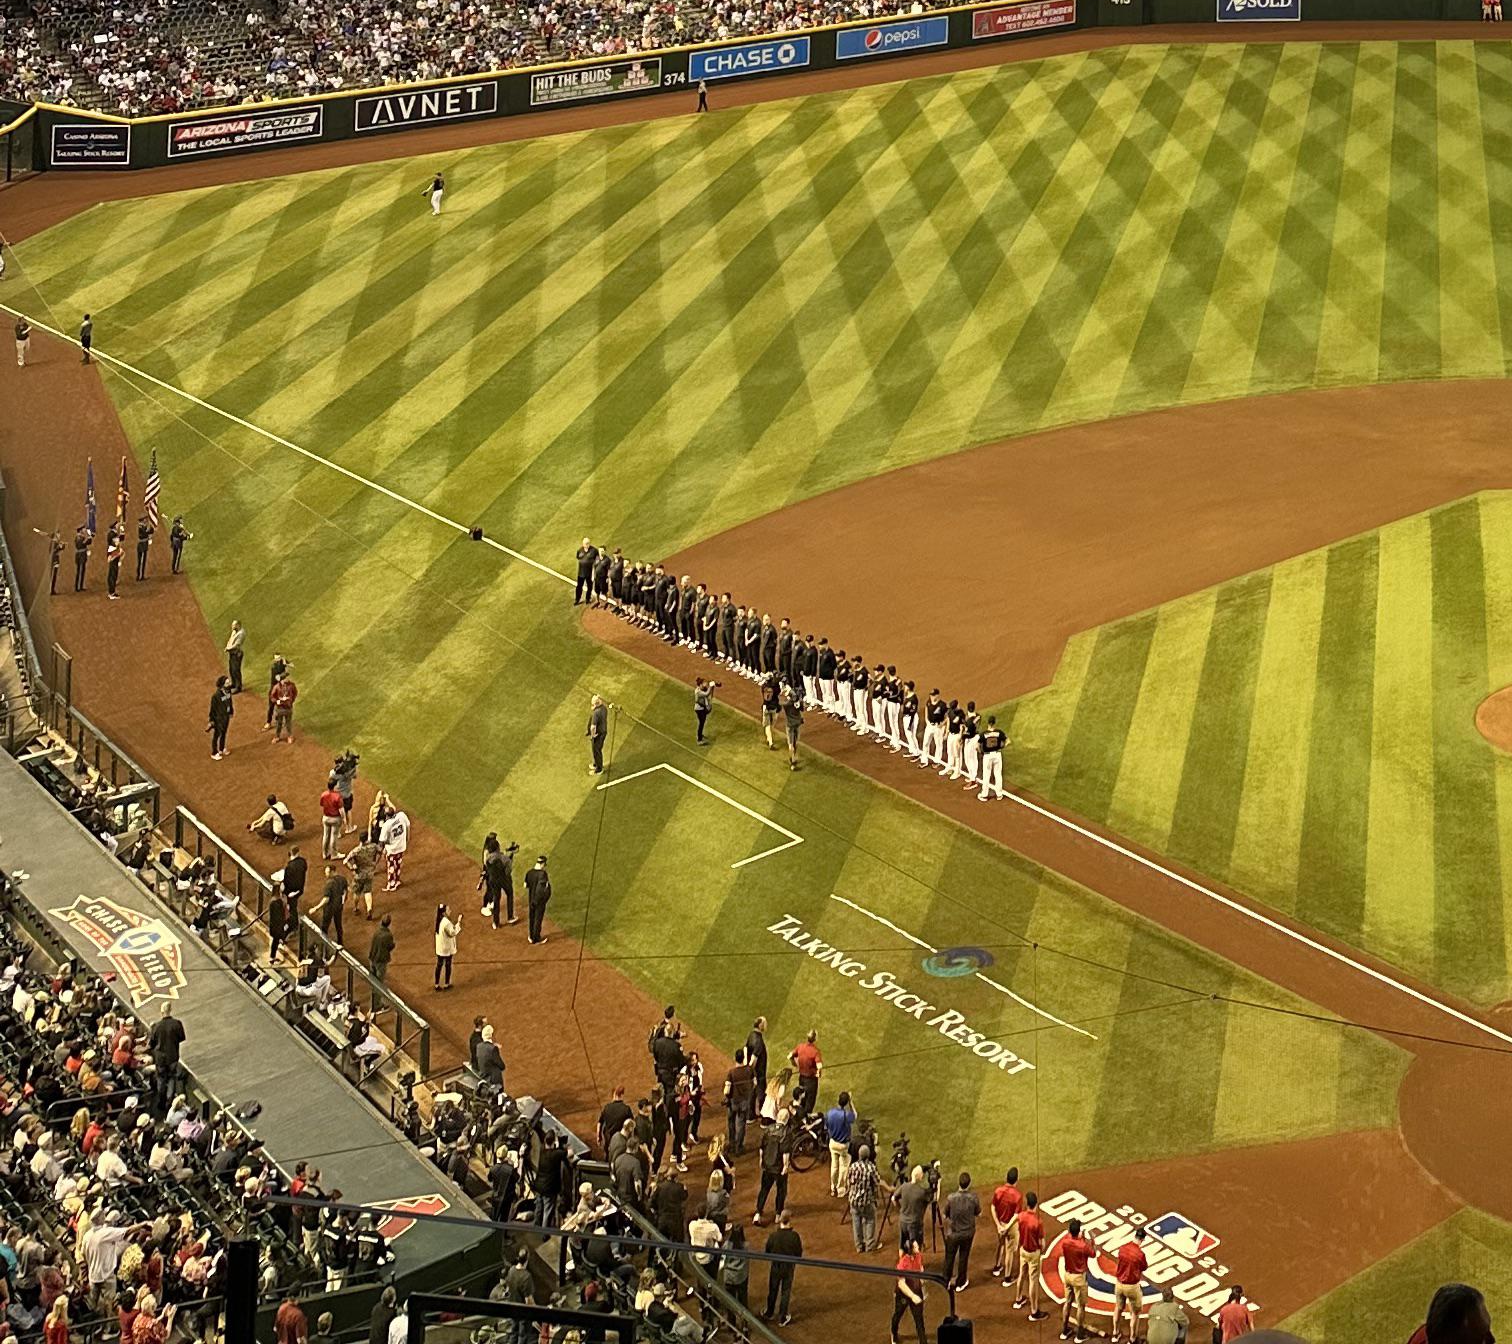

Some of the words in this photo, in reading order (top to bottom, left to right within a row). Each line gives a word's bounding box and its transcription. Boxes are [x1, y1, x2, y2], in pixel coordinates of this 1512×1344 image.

[884, 27, 922, 47] pepsi
[704, 47, 775, 74] CHASE
[536, 75, 555, 90] HIT
[557, 72, 579, 87] THE
[581, 68, 612, 84] BUDS
[664, 72, 686, 86] 374
[371, 87, 483, 124] AVNET
[177, 140, 197, 151] THE
[199, 136, 232, 149] LOCAL
[233, 130, 274, 144] SPORTS
[276, 125, 314, 138] LEADER
[178, 120, 247, 140] ARIZONA
[251, 113, 311, 130] SPORTS
[85, 905, 128, 934] CHASE
[139, 953, 172, 988] FIELD
[766, 914, 865, 979] TALKING
[858, 968, 933, 1020] STICK
[927, 1007, 1035, 1076] RESORT
[1116, 1205, 1148, 1226] 20
[1198, 1256, 1229, 1277] 23
